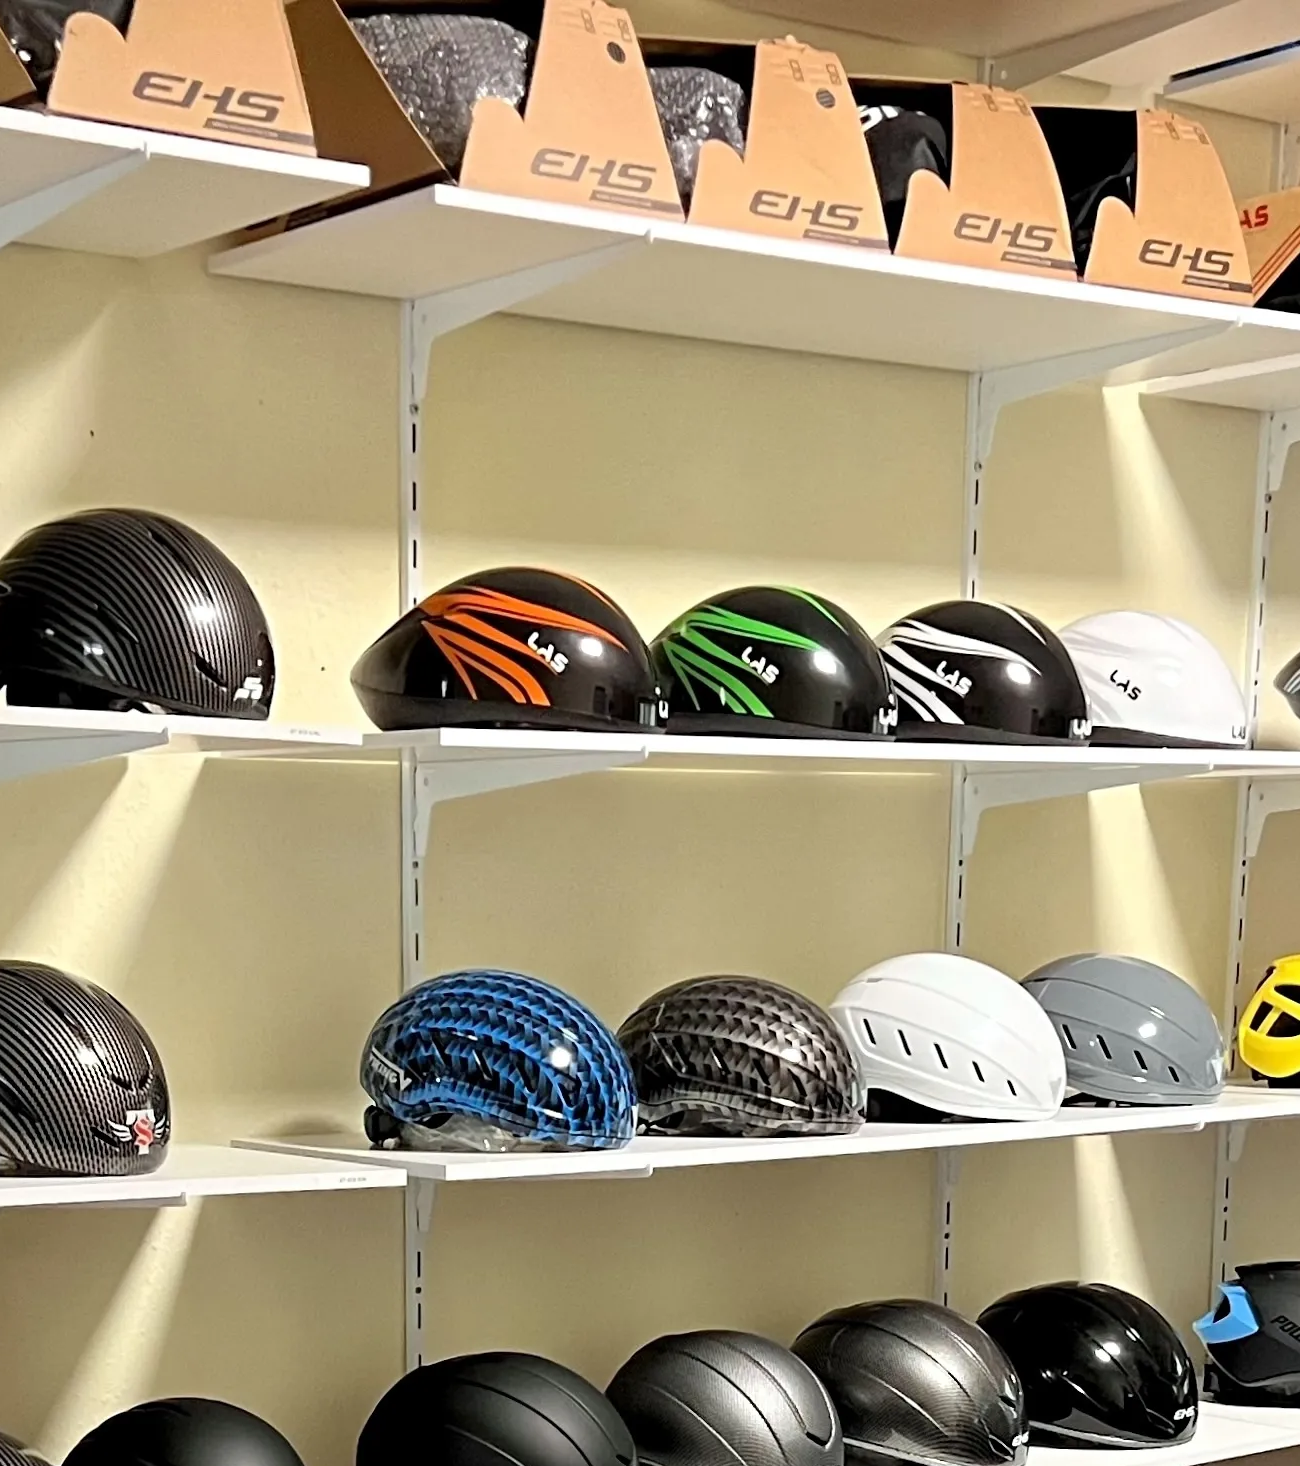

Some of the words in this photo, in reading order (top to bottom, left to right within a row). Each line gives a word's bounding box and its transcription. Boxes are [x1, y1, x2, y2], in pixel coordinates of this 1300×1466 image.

[132, 71, 286, 123] EHS
[529, 148, 658, 193] EHS
[748, 189, 863, 232] EHS
[1240, 204, 1269, 229] AS
[953, 212, 1058, 253] EHS
[1138, 238, 1234, 276] EHS
[527, 632, 569, 674] LAS
[741, 645, 780, 686] LAS
[936, 660, 973, 696] LAS
[1110, 669, 1143, 701] LAS
